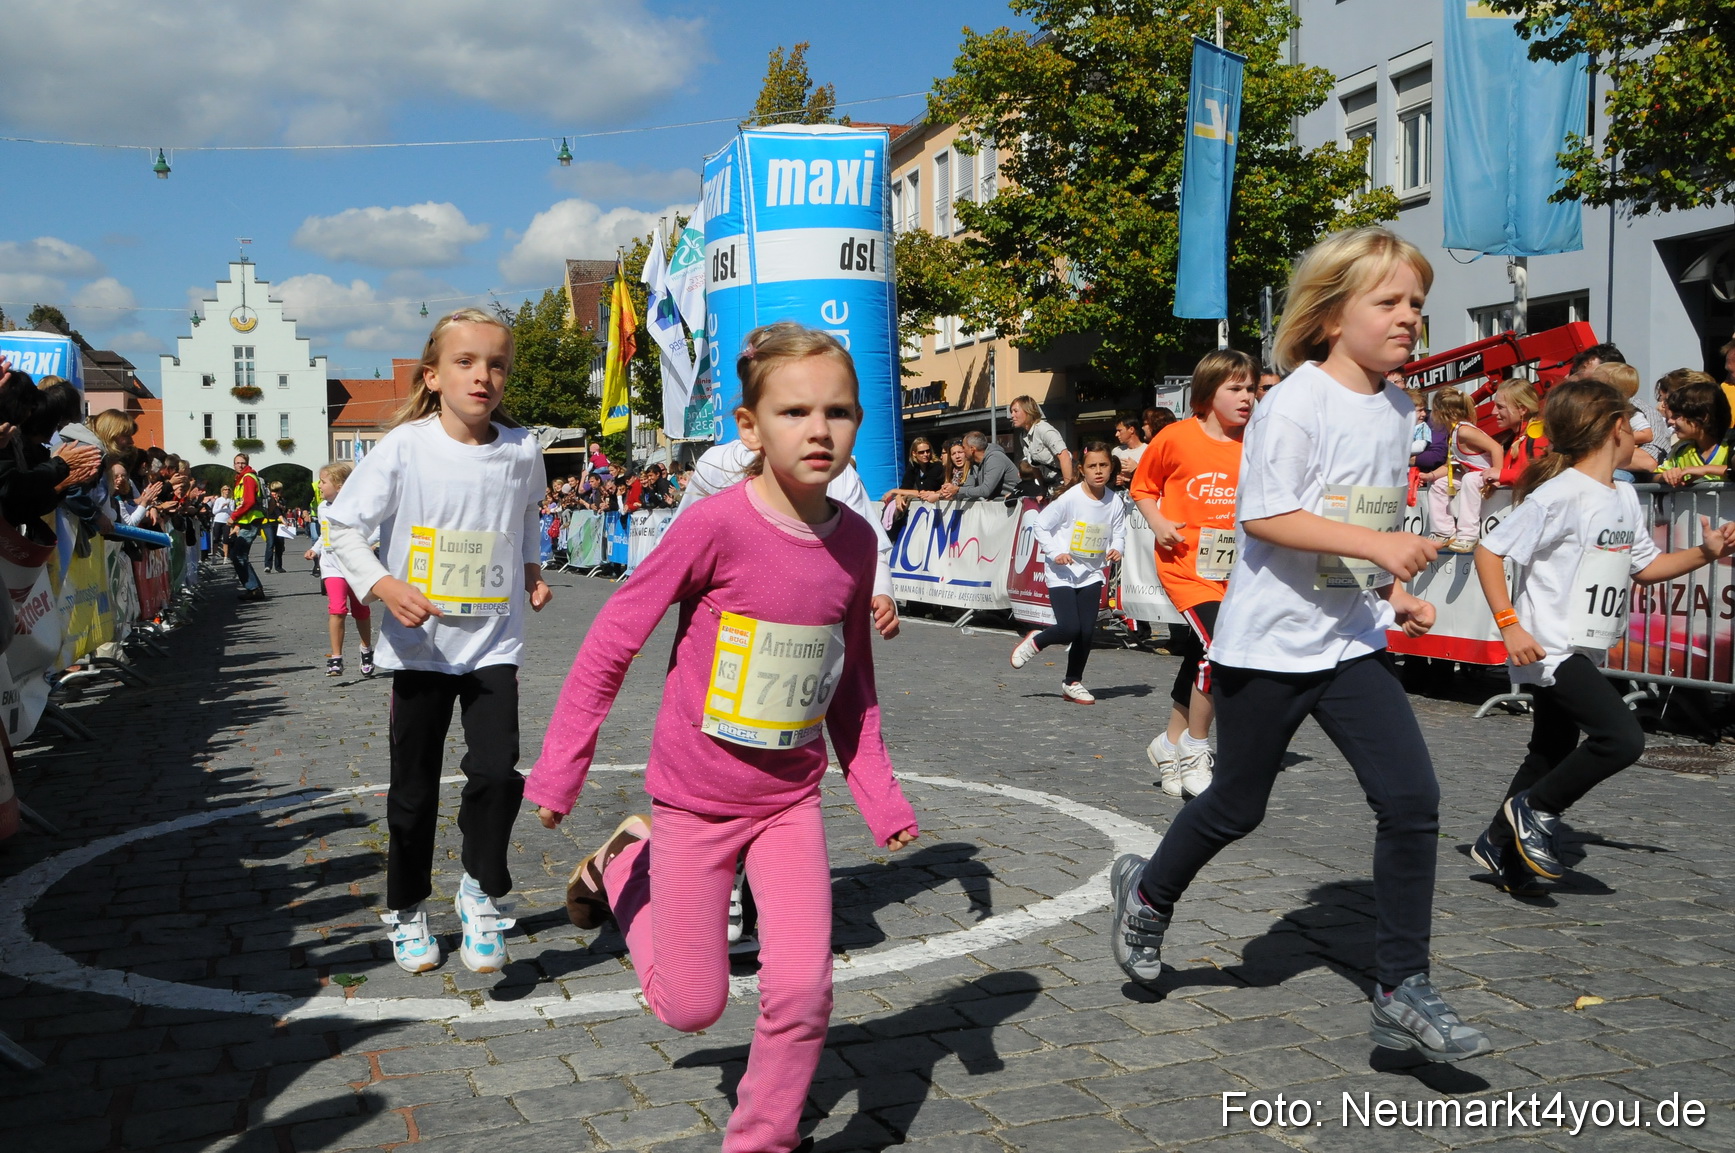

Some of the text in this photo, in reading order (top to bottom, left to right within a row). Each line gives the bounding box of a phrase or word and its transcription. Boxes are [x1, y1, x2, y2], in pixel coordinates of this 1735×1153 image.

[766, 149, 876, 207] maxi
[713, 243, 737, 282] dsl
[840, 236, 876, 272] dsl
[1, 347, 62, 376] maxi
[1199, 484, 1238, 497] Fisc
[1356, 494, 1398, 514] Andrea
[440, 536, 483, 554] Louisa
[1085, 536, 1108, 547] 7197
[1200, 547, 1209, 555] K3
[414, 557, 427, 571] K3
[1216, 549, 1239, 564] 71
[440, 563, 505, 588] 7113
[1124, 583, 1165, 596] www.ort
[758, 632, 825, 659] Antonia
[718, 660, 738, 681] K3
[757, 671, 832, 708] 7196
[718, 722, 758, 740] BOCK
